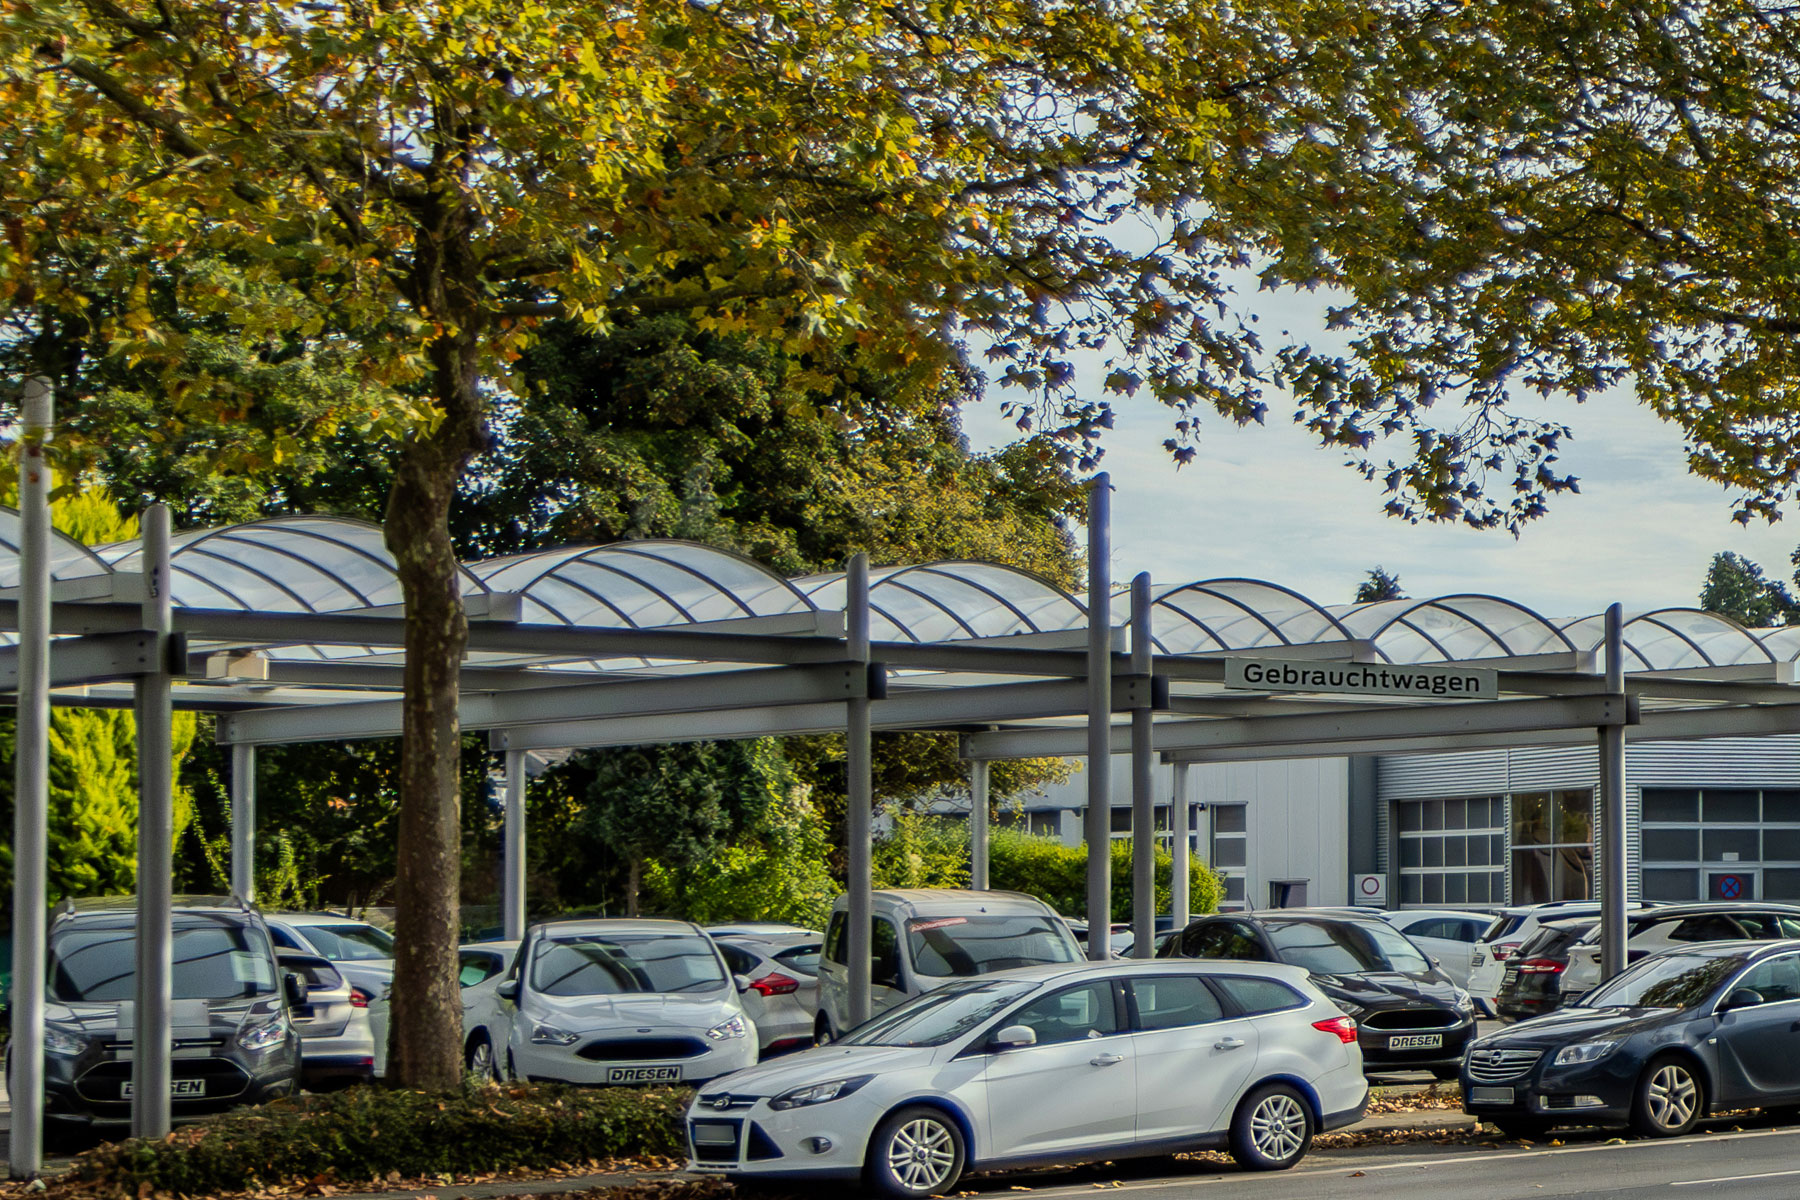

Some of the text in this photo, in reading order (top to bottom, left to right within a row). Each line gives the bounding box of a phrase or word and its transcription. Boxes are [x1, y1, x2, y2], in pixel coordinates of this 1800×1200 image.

[1243, 663, 1480, 694] Gebrauchtwagen
[1392, 1036, 1440, 1047] DRESEN
[611, 1068, 678, 1081] DRESEN
